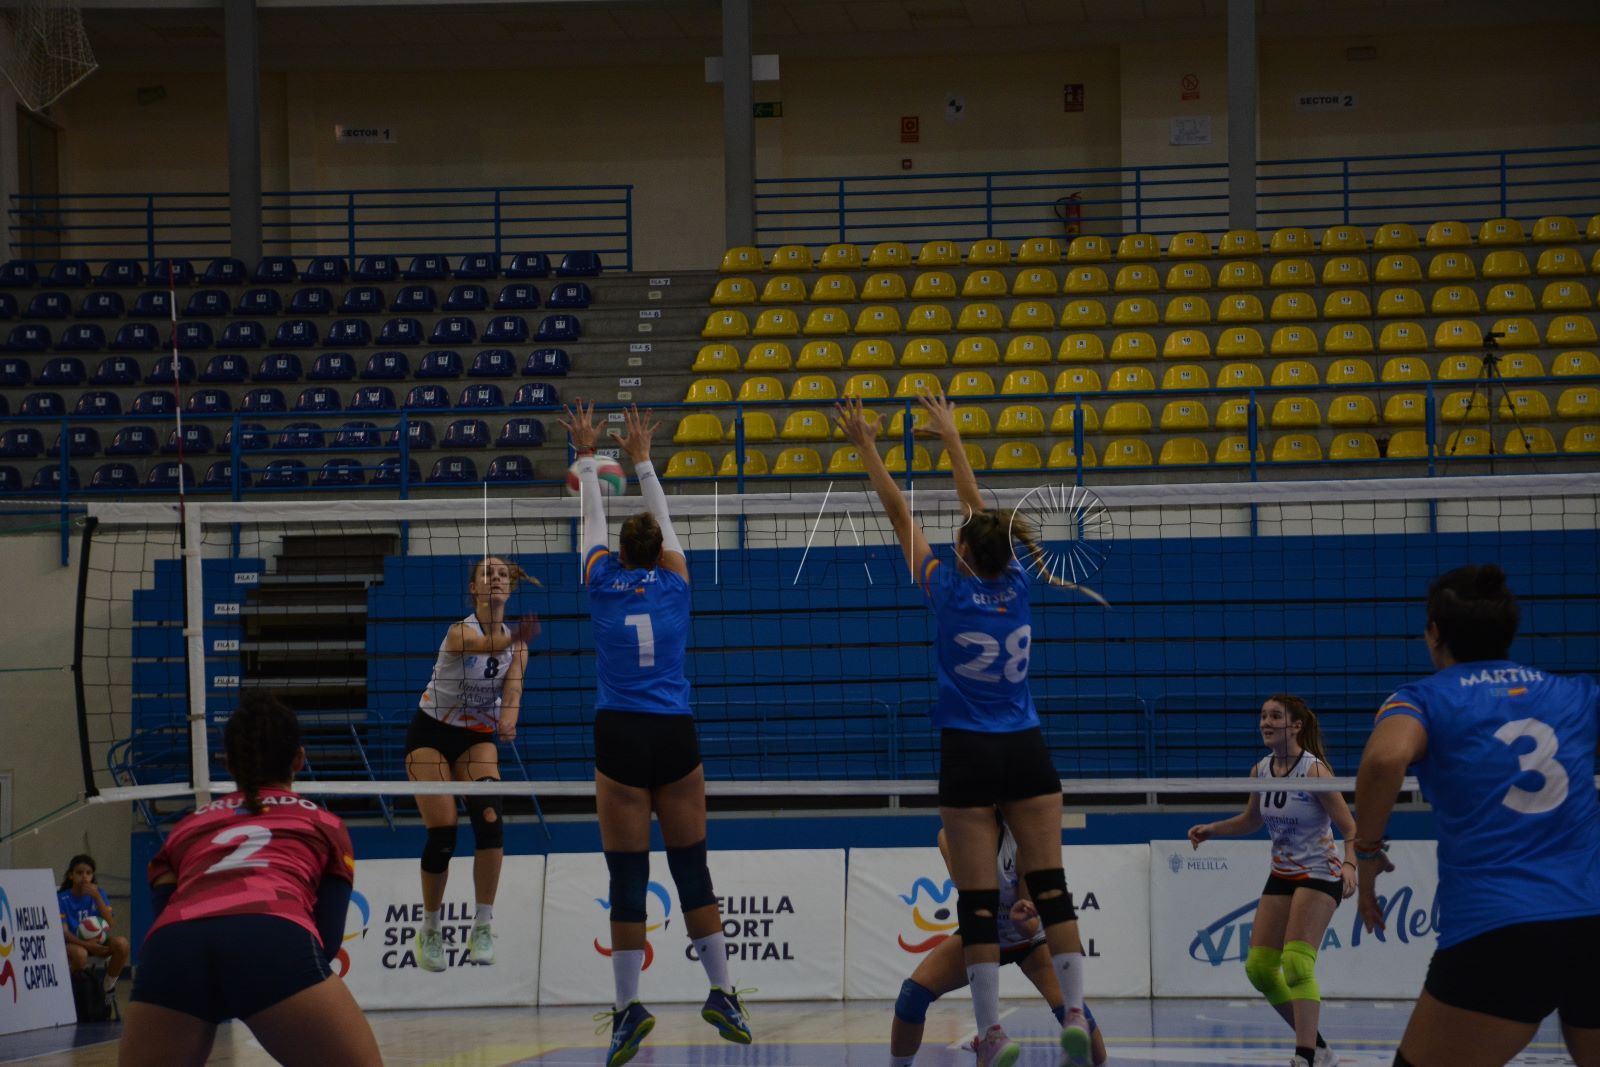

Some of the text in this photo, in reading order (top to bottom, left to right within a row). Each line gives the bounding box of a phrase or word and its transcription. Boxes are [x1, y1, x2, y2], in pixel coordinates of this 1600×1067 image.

[1299, 96, 1353, 107] SECTOR 2
[383, 129, 390, 140] 1
[624, 613, 656, 668] 1
[953, 624, 1032, 684] 28
[484, 656, 499, 678] 8
[1492, 718, 1569, 815] 3
[194, 796, 318, 815] CRUADO
[204, 825, 273, 874] 2
[1188, 862, 1228, 870] MELILLA
[385, 902, 494, 922] MEILL
[716, 896, 795, 914] ELILLA
[16, 906, 50, 932] MELILLA
[722, 918, 774, 938] ORT
[384, 926, 472, 946] SPRT
[20, 935, 47, 962] SPORT
[382, 949, 477, 968] CATA
[686, 942, 794, 961] CPITAL
[24, 963, 59, 990] CAPITAL
